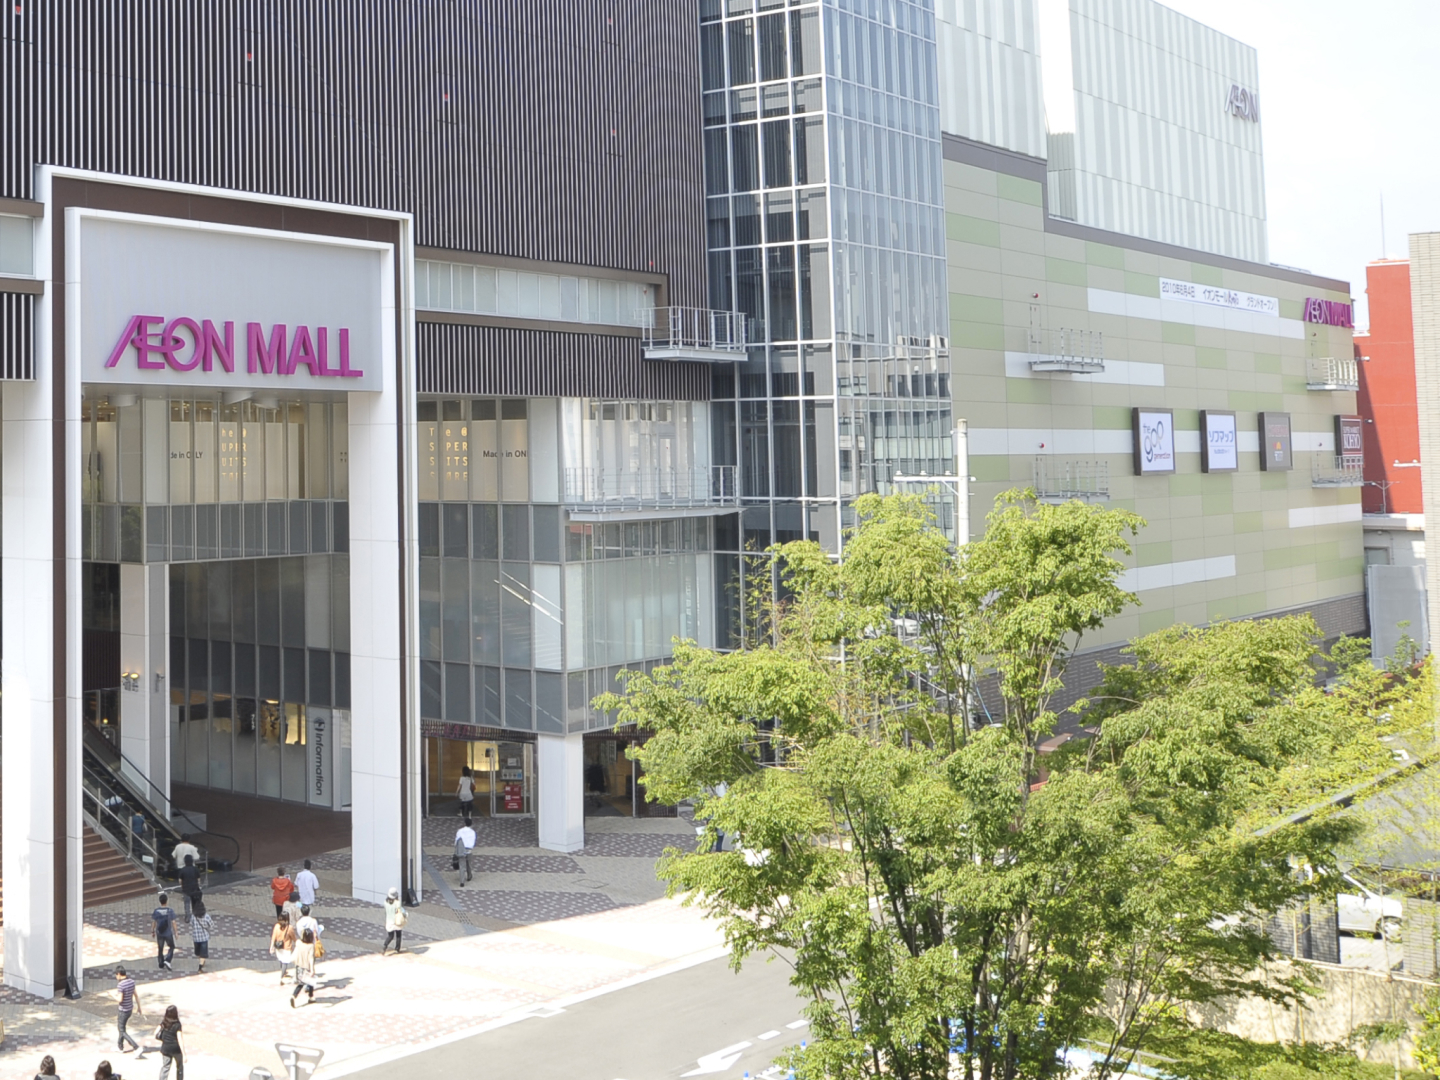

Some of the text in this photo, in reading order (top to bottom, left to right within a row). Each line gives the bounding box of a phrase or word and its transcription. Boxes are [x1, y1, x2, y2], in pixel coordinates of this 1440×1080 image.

[1330, 301, 1355, 329] MALL
[247, 322, 364, 378] MALL
[429, 442, 468, 451] SPER
[186, 451, 203, 459] OLY
[506, 449, 513, 458] in
[429, 457, 468, 466] SITS
[315, 732, 324, 796] Information
